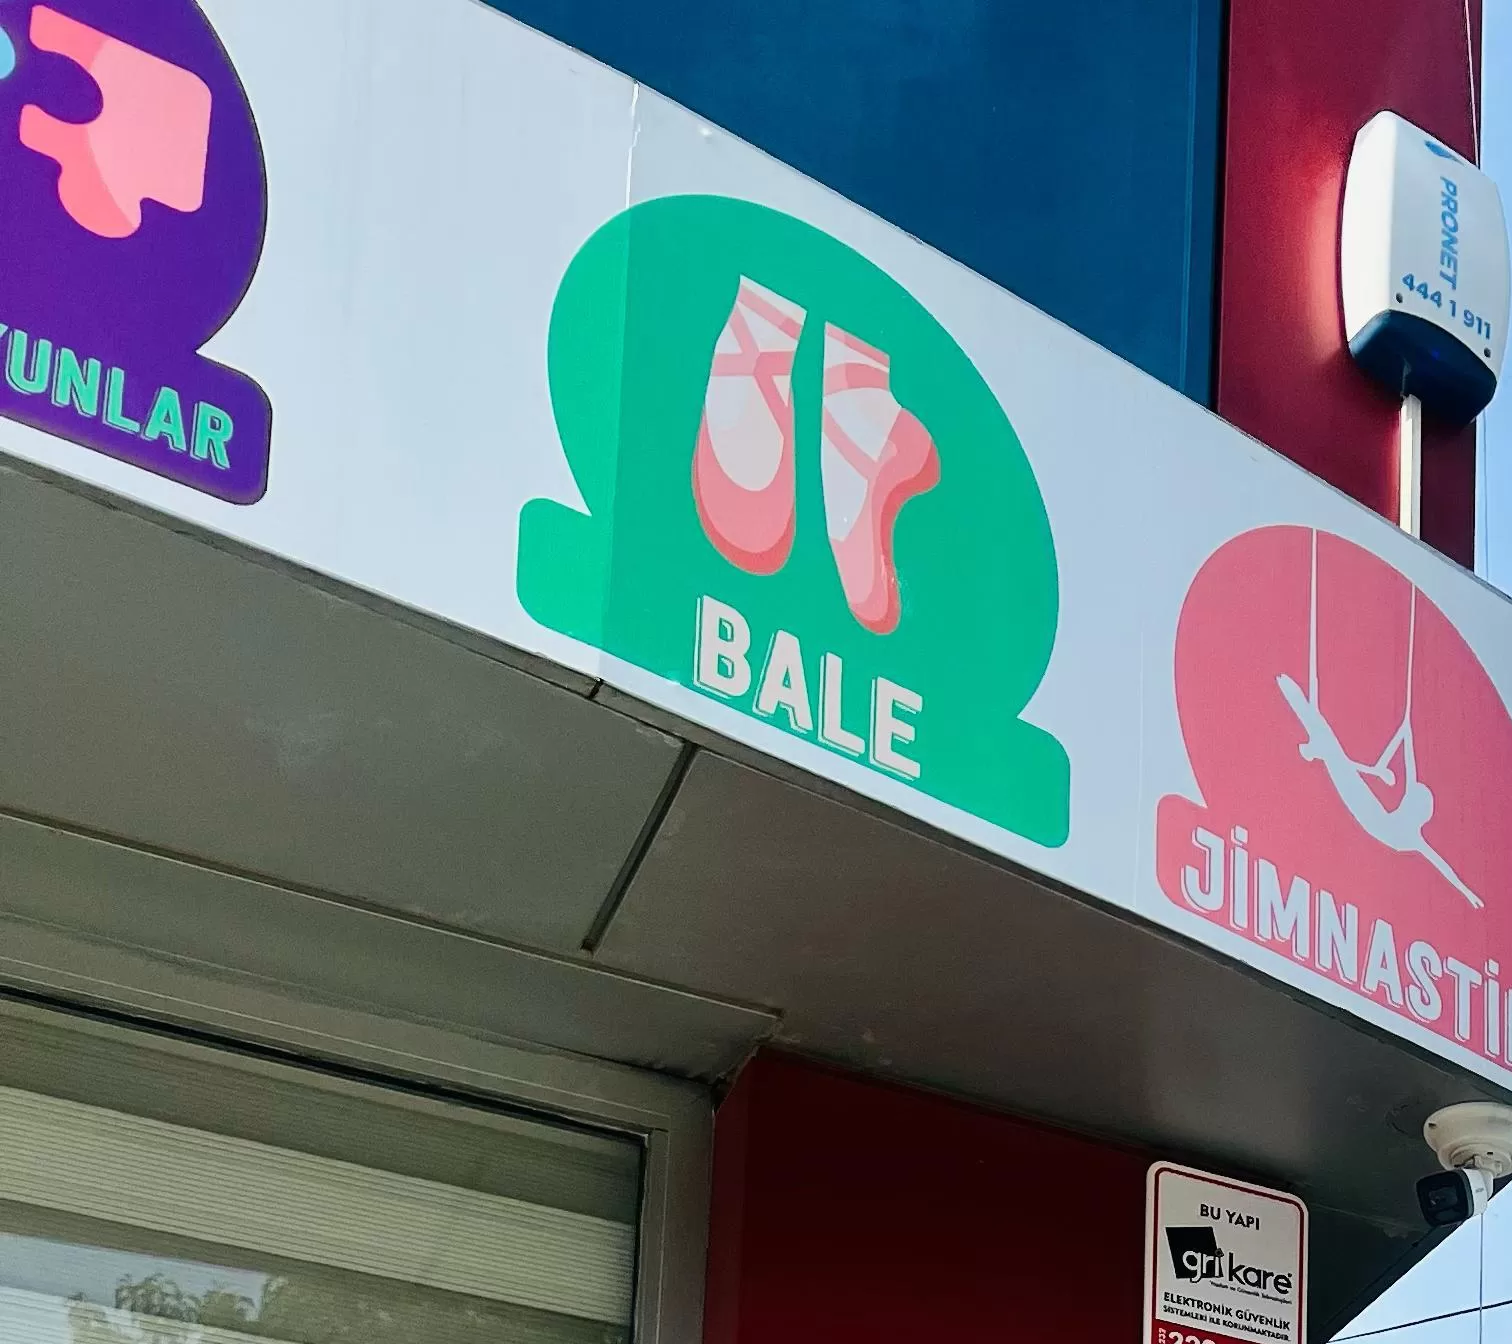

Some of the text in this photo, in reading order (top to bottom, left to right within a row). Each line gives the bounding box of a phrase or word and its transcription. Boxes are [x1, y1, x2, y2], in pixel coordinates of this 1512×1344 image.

[1439, 175, 1459, 291] PRONET
[1402, 273, 1491, 340] 444 1 911
[0, 322, 234, 470] UNLAR
[693, 594, 924, 781] BALE
[1200, 1203, 1260, 1231] BU YAPI
[1163, 1291, 1233, 1318] ELEKTRONİK
[1235, 1308, 1290, 1331] GÜVENLİK
